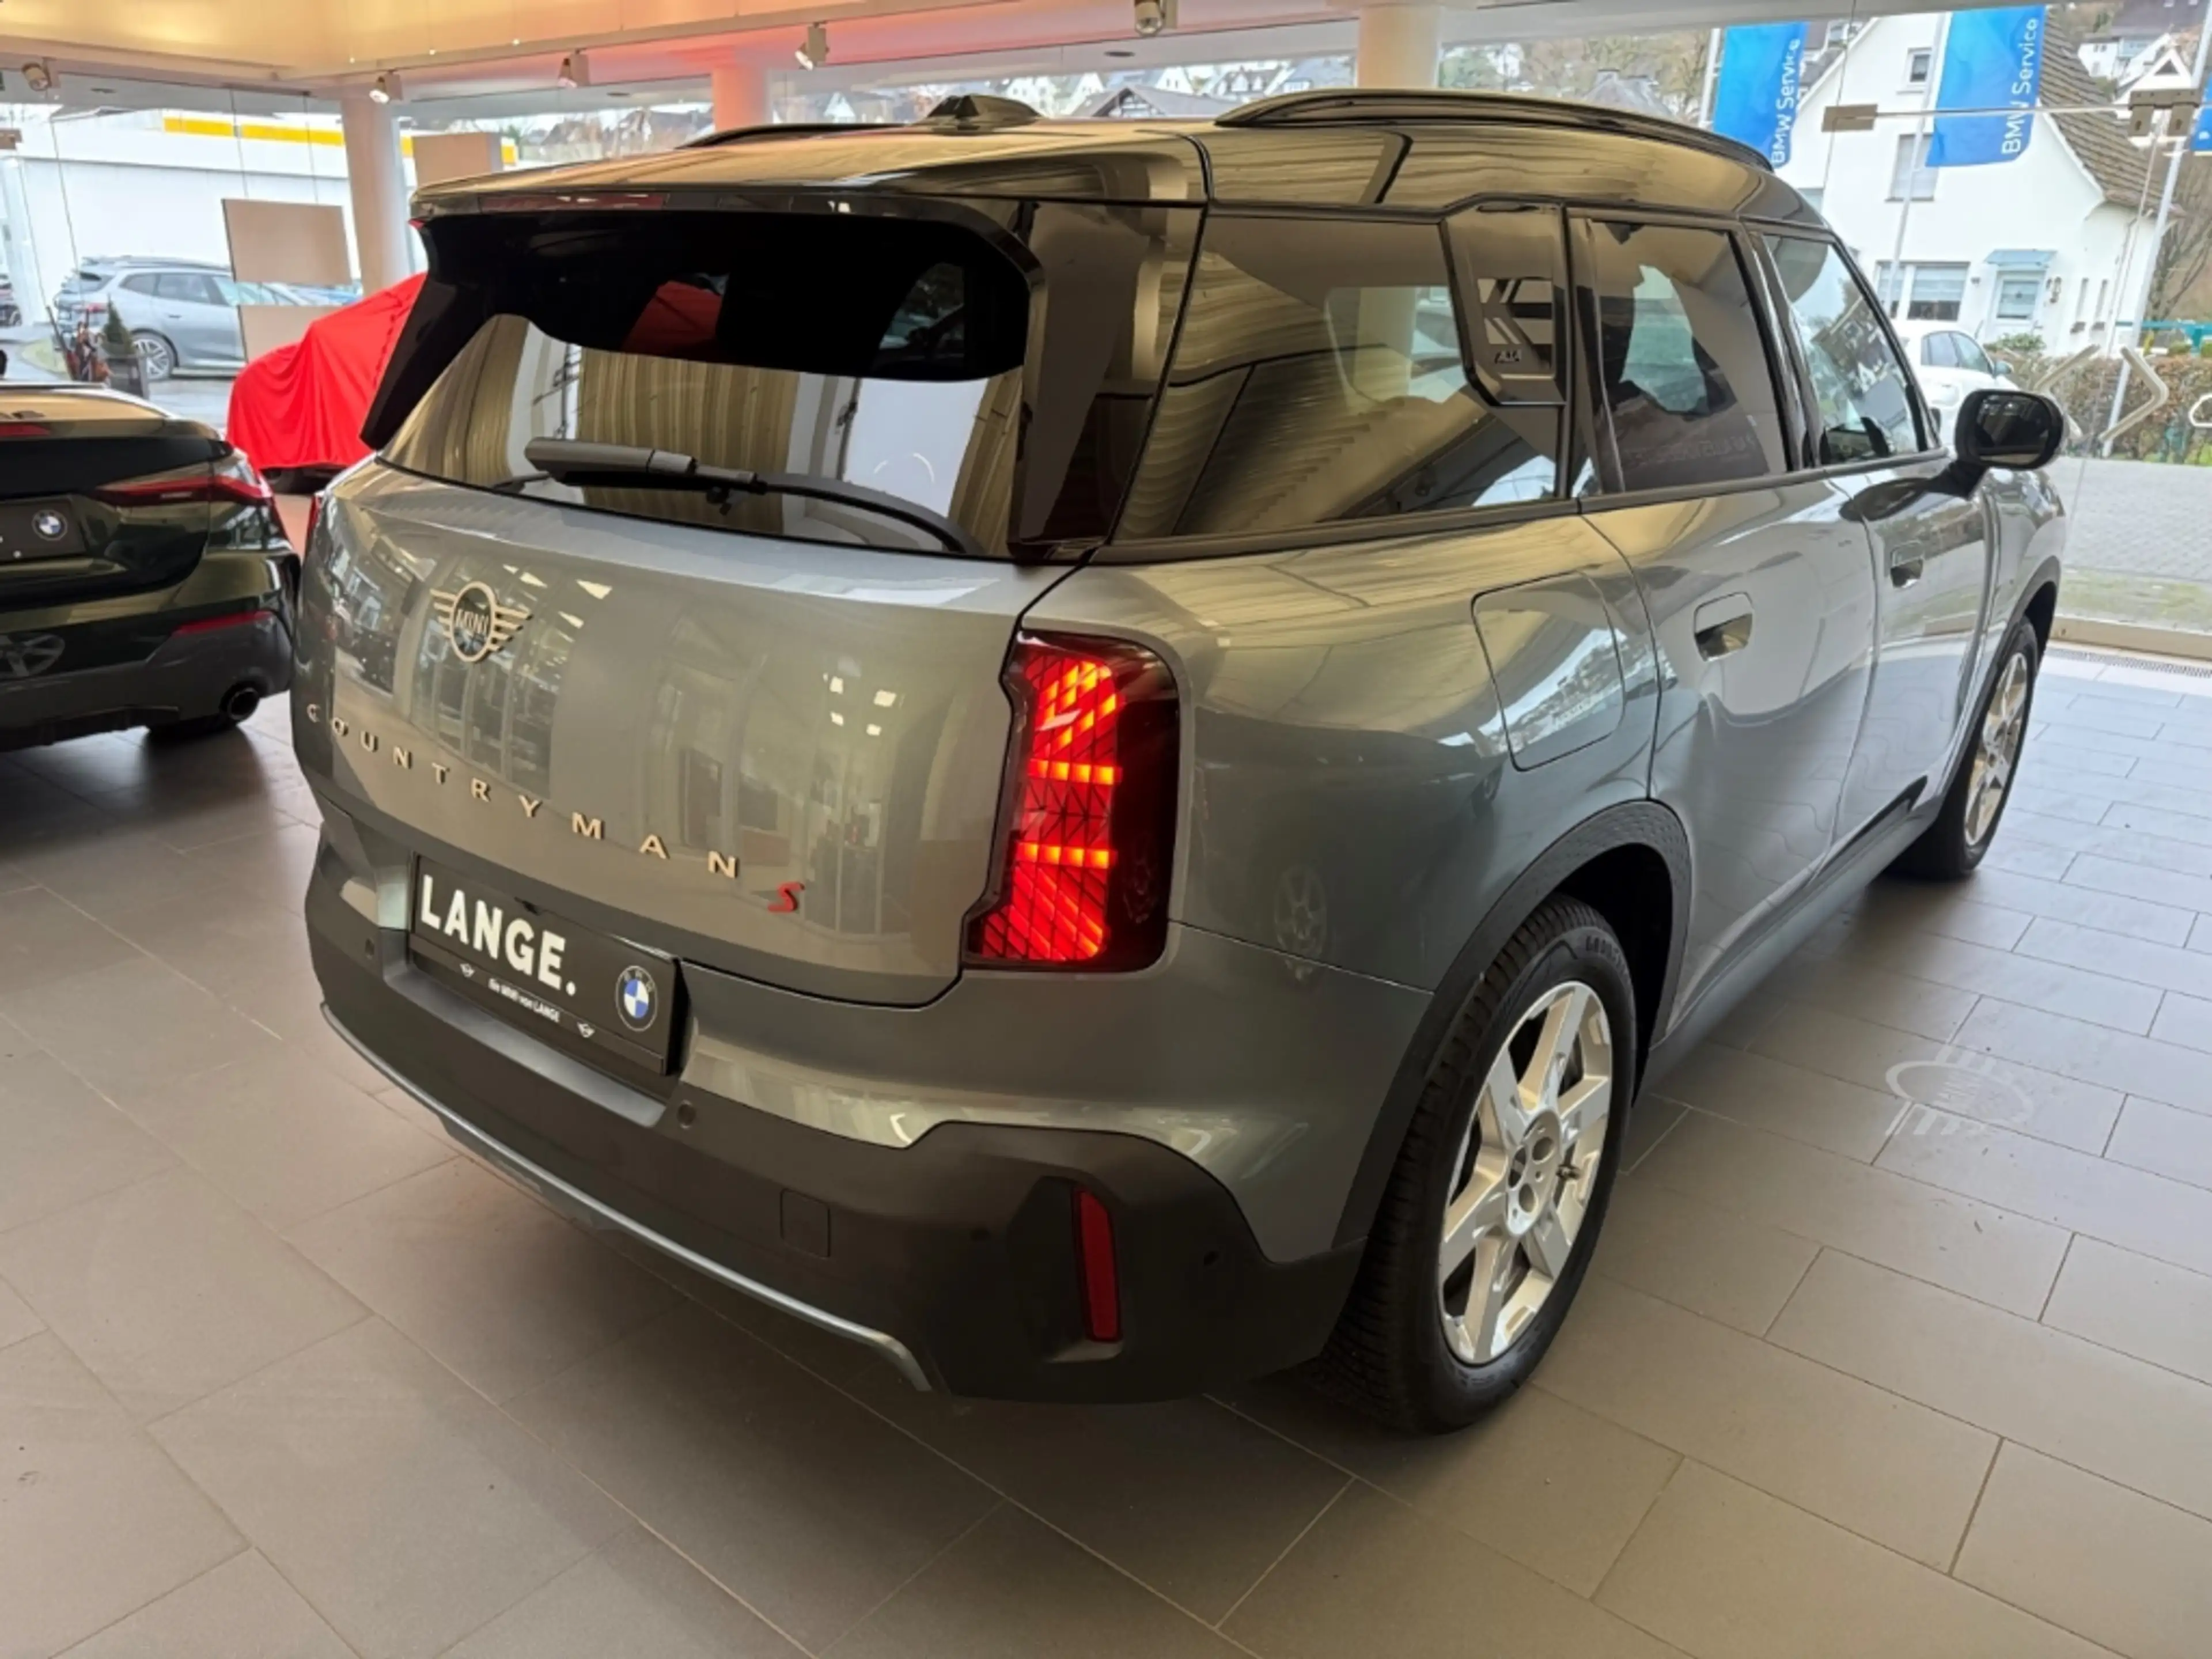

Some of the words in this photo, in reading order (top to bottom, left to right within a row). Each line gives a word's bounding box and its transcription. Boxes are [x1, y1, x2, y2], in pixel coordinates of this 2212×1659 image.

[2012, 18, 2039, 94] Service
[1771, 114, 1791, 163] BMW
[2001, 100, 2029, 154] BMW
[306, 703, 738, 878] COUNTRYMAN
[767, 881, 805, 913] S
